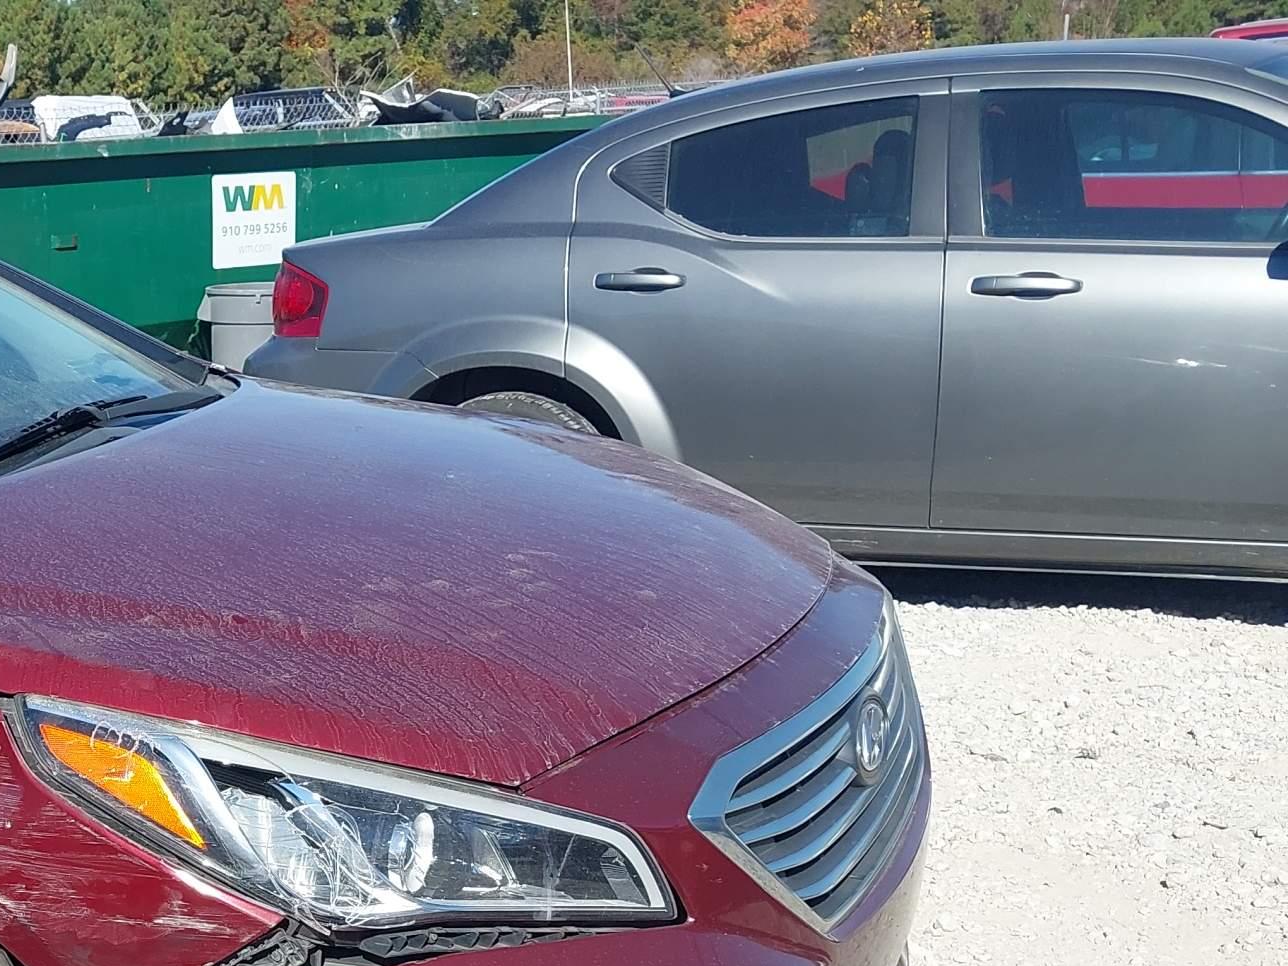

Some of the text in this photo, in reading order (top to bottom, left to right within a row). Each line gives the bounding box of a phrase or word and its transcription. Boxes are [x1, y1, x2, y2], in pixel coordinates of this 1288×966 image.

[222, 184, 284, 212] WM
[221, 222, 288, 237] 910 799 5256
